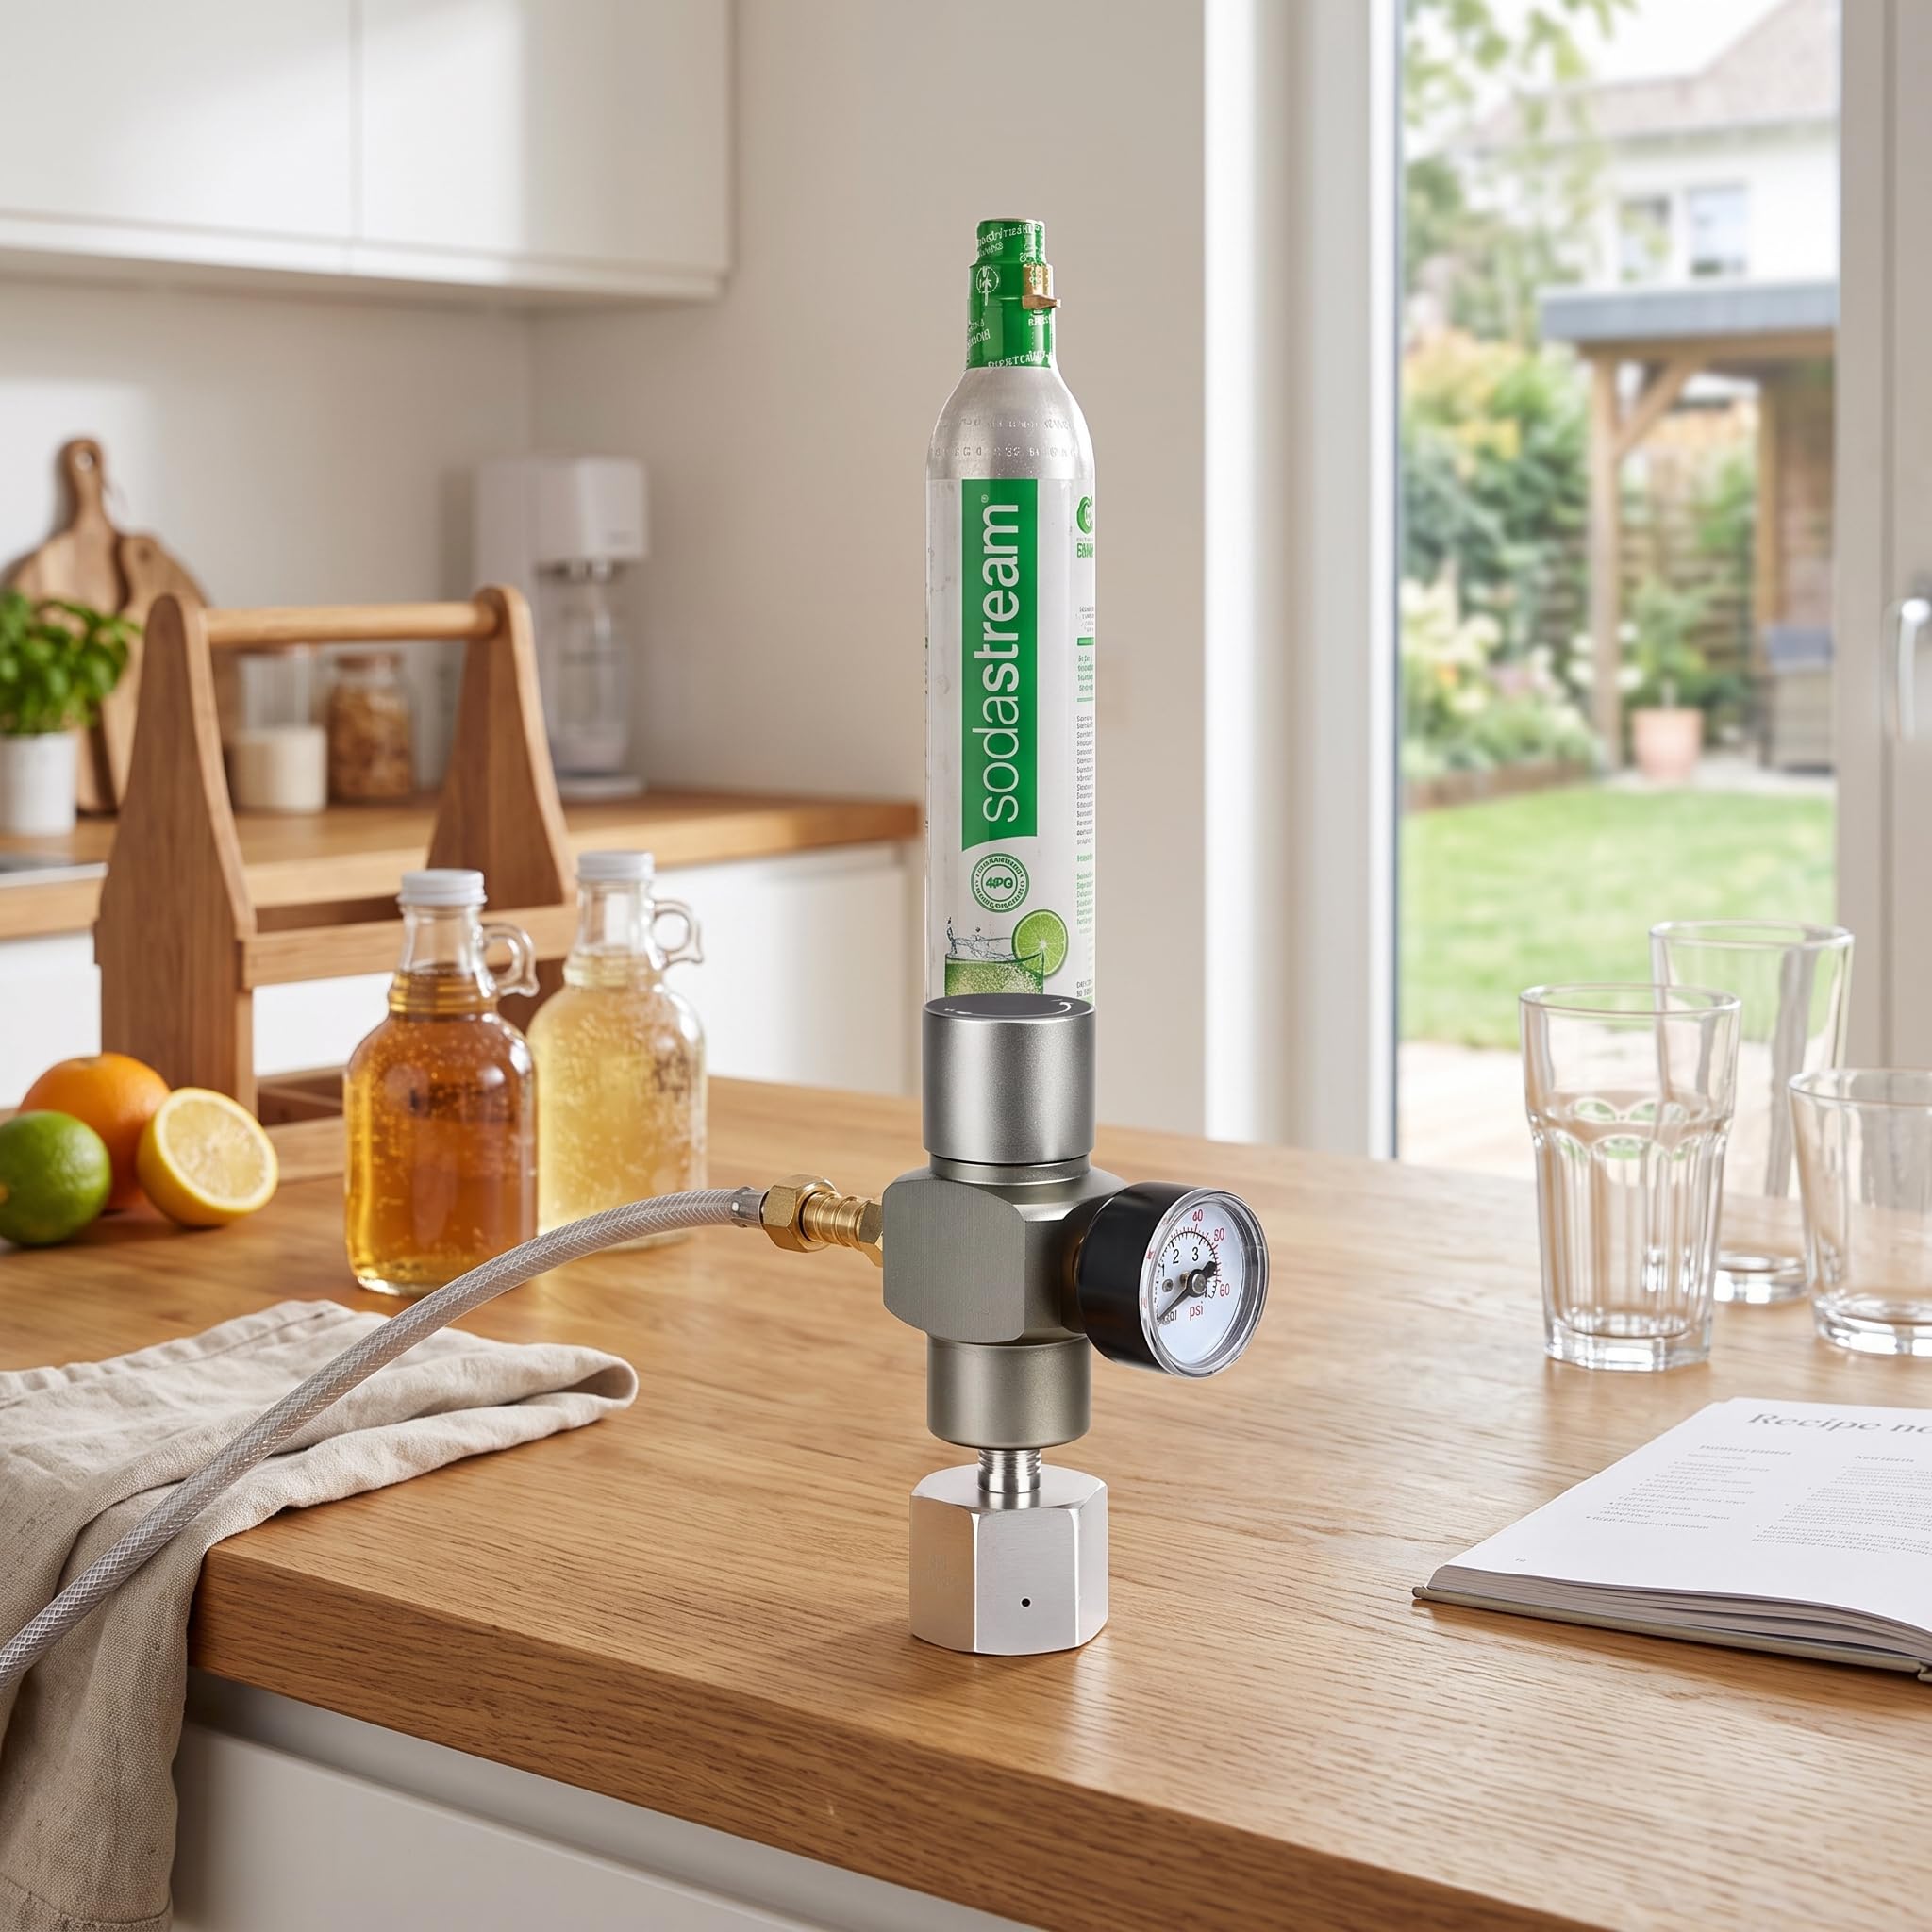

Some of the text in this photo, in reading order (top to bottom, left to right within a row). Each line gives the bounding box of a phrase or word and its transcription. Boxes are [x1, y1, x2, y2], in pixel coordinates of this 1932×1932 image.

[972, 503, 1020, 823] sodastream
[1173, 1246, 1199, 1264] 2 3
[1219, 1283, 1230, 1297] 60
[1189, 1301, 1204, 1321] psi
[1747, 1413, 1881, 1431] Recipe
